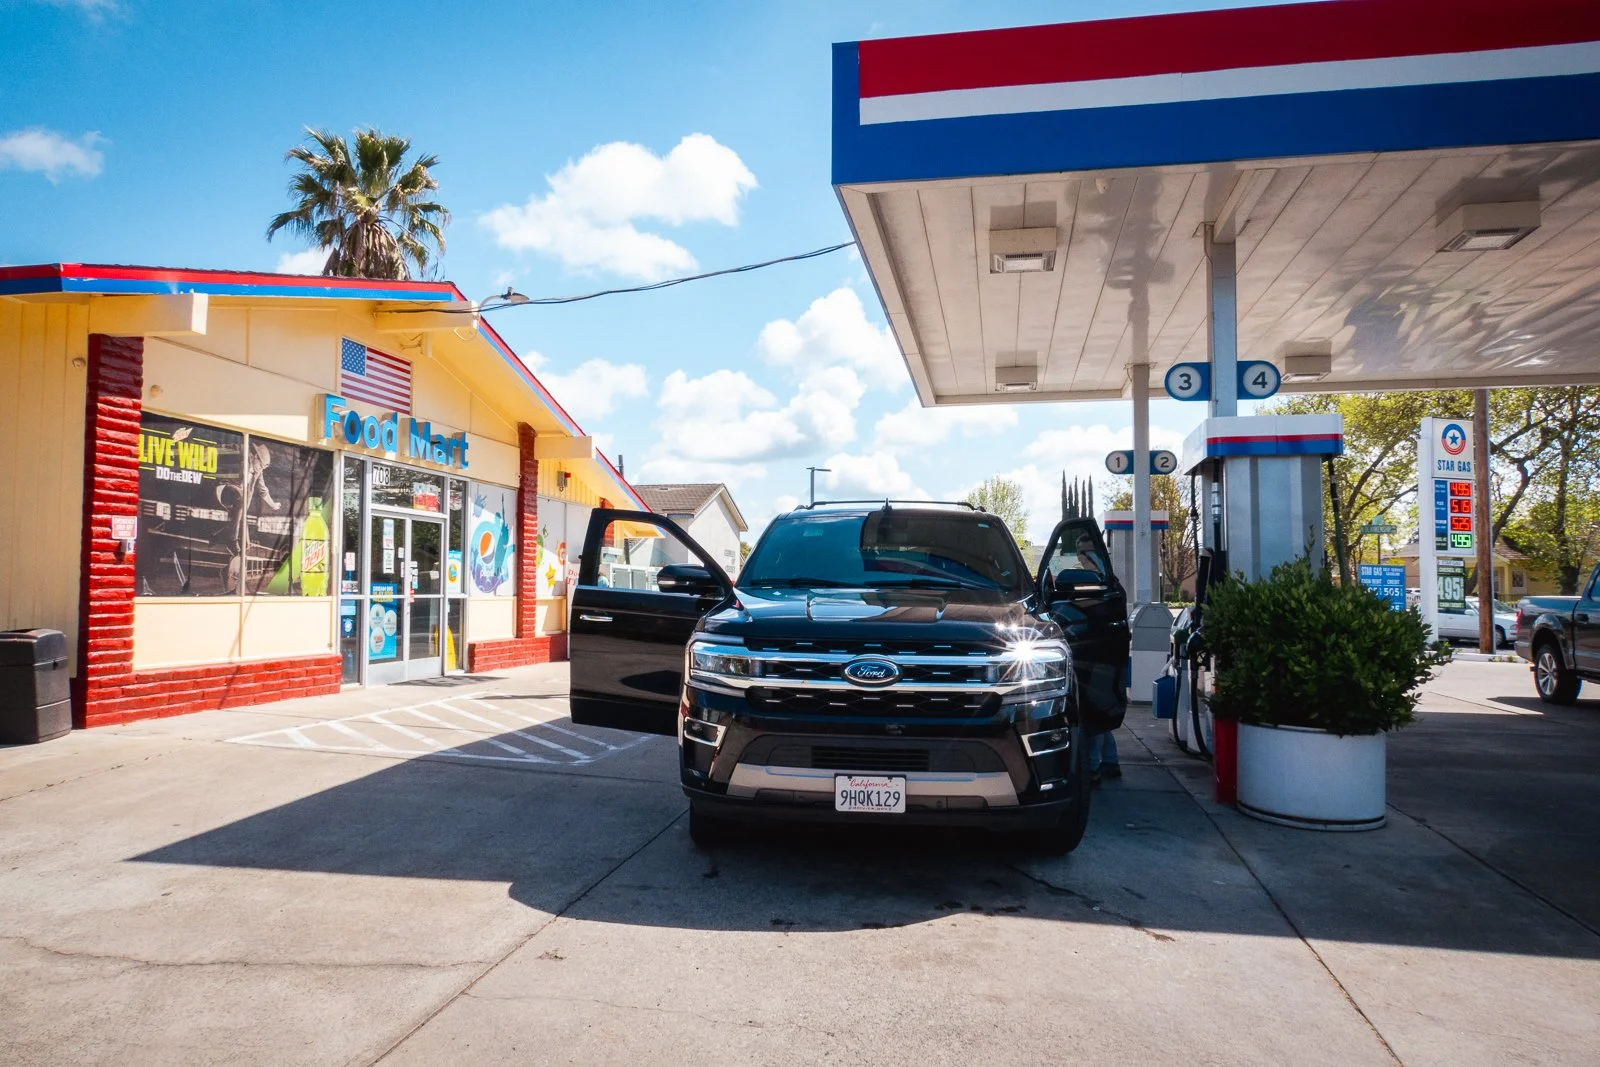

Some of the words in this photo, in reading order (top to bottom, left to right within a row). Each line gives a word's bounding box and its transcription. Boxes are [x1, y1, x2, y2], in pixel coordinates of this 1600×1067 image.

[1177, 373, 1192, 390] 3
[1251, 371, 1268, 389] 4
[323, 393, 398, 453] Food
[409, 417, 469, 470] Mart
[138, 433, 175, 467] LIVE
[178, 441, 217, 473] WILD
[1114, 457, 1121, 468] 1
[1159, 457, 1169, 468] 2
[1437, 460, 1455, 472] STAR
[1457, 461, 1471, 473] GAS
[373, 466, 391, 485] 708
[1361, 566, 1372, 575] STAR
[1373, 567, 1382, 576] GAS
[1383, 587, 1400, 597] 505
[857, 665, 885, 678] Ford
[850, 778, 892, 790] California
[840, 789, 901, 808] 9HQK129
